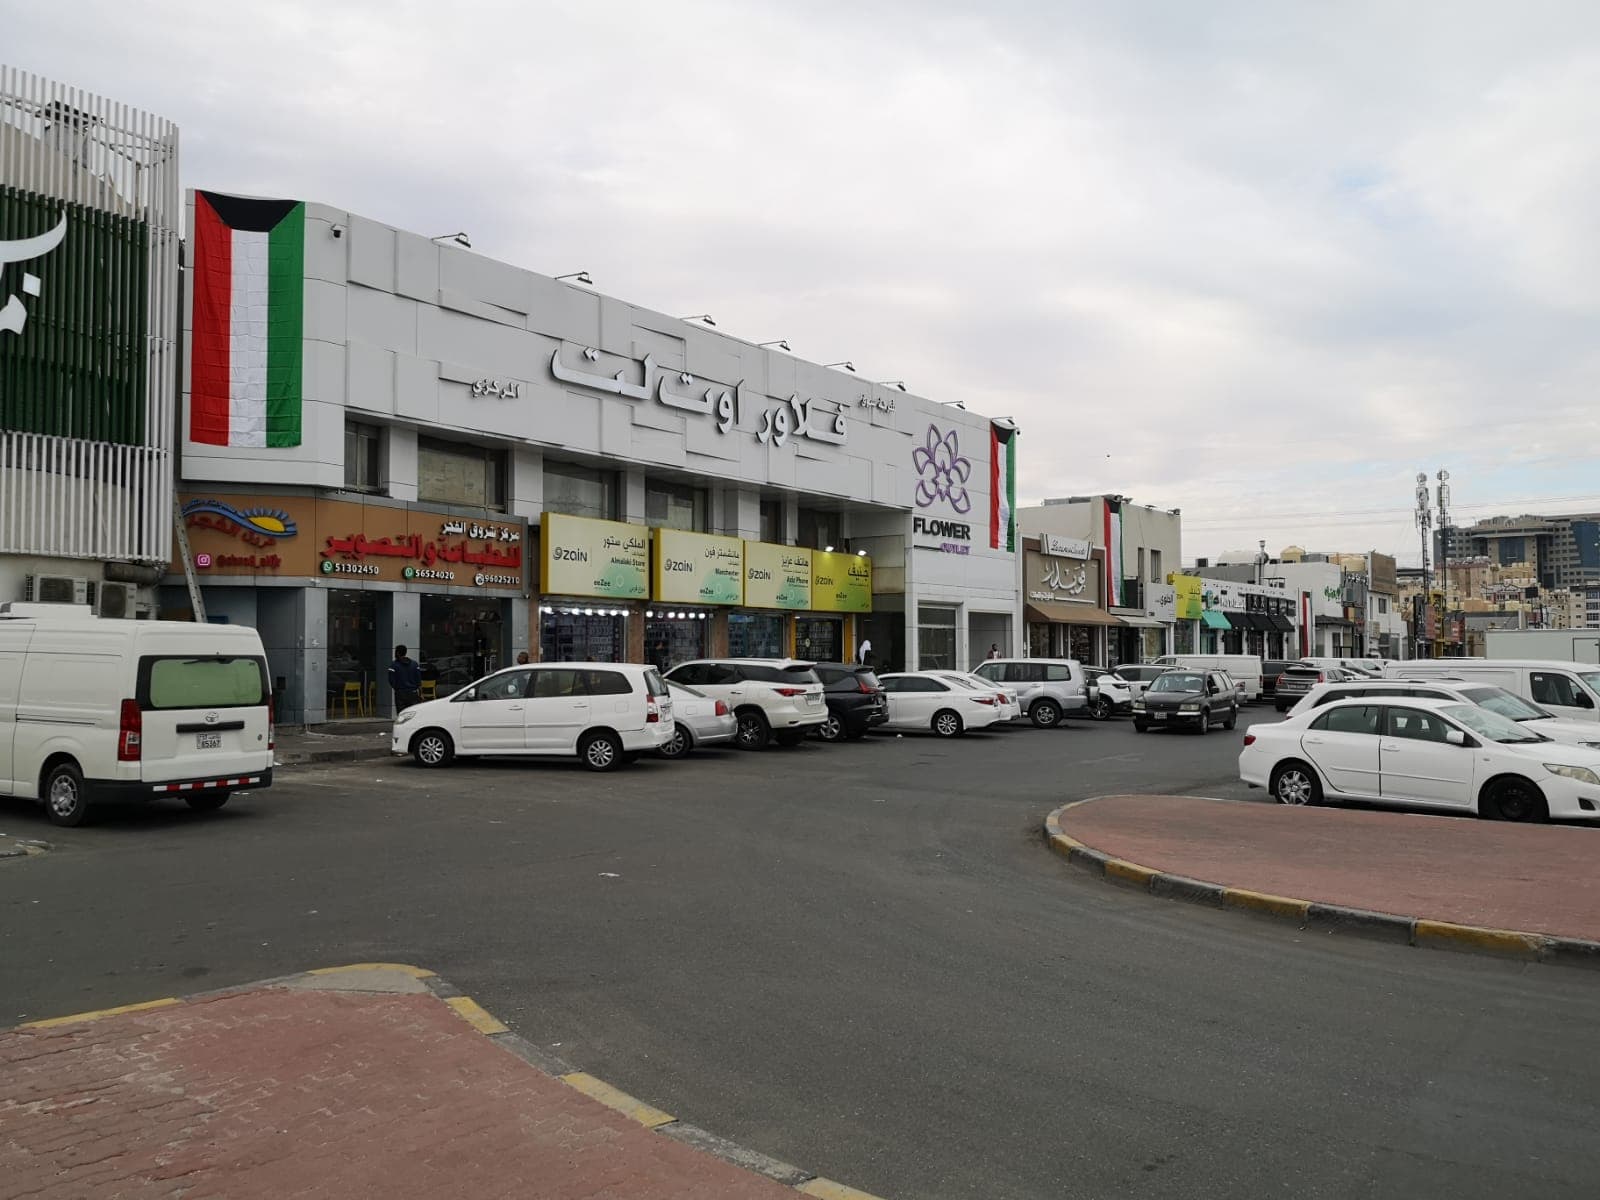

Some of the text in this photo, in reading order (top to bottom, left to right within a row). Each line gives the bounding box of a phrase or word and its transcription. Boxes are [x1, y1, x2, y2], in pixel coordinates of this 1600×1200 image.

[471, 379, 519, 399] المركزي
[657, 371, 744, 434] اوت
[756, 391, 847, 446] فلاور
[443, 521, 520, 542] مركز شروق الفجر
[913, 516, 971, 540] FLOWER
[603, 535, 620, 549] ستور
[335, 563, 379, 575] 51302450
[415, 568, 454, 580] 56524020
[484, 574, 520, 584] 96025210
